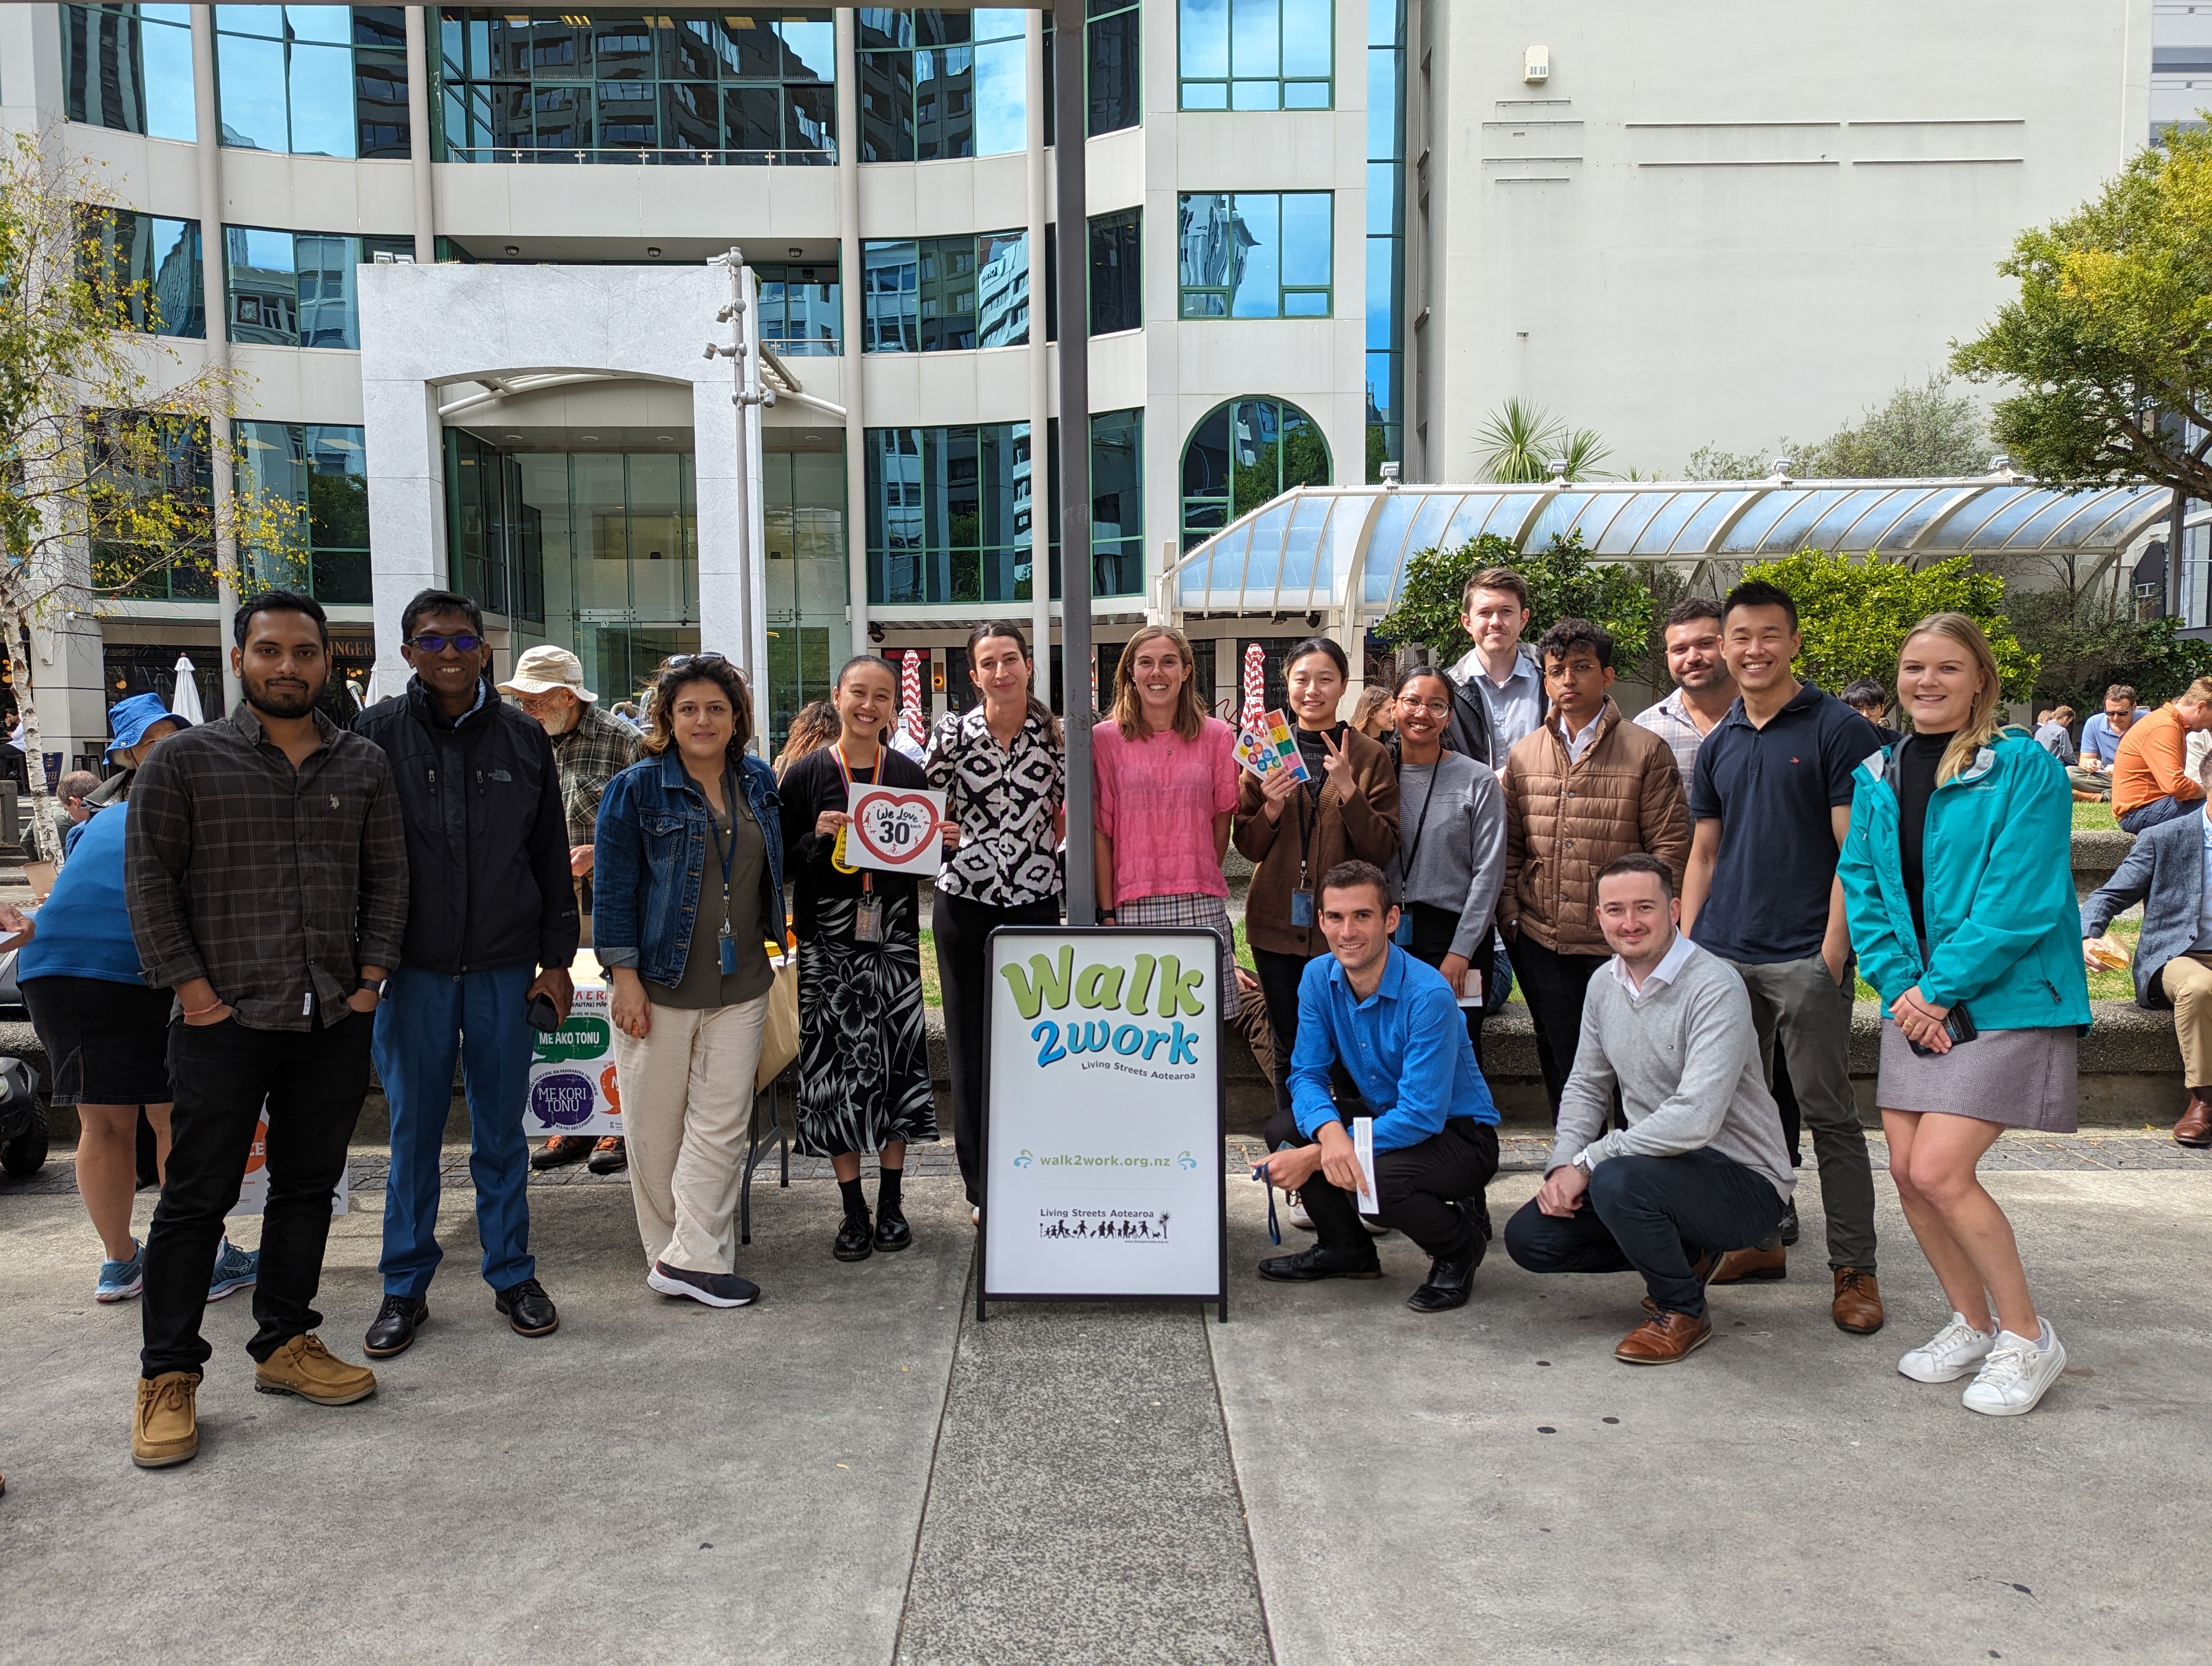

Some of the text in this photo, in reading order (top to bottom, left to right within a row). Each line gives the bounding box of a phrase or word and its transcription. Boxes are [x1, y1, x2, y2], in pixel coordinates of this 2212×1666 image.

[329, 642, 373, 656] INGER
[877, 807, 918, 823] We Love
[879, 821, 910, 844] 30
[1000, 944, 1205, 1020] Walk
[586, 991, 593, 1000] E
[539, 1032, 600, 1045] ME AKO TONU
[1031, 1019, 1199, 1067] 2work
[1082, 1060, 1195, 1080] Living Streets Aotearoa
[538, 1087, 587, 1100] ME KORI
[545, 1099, 580, 1112] TONU
[1040, 1155, 1170, 1168] walk2work.org.nz
[1040, 1208, 1154, 1218] Living Streets Aotearoa
